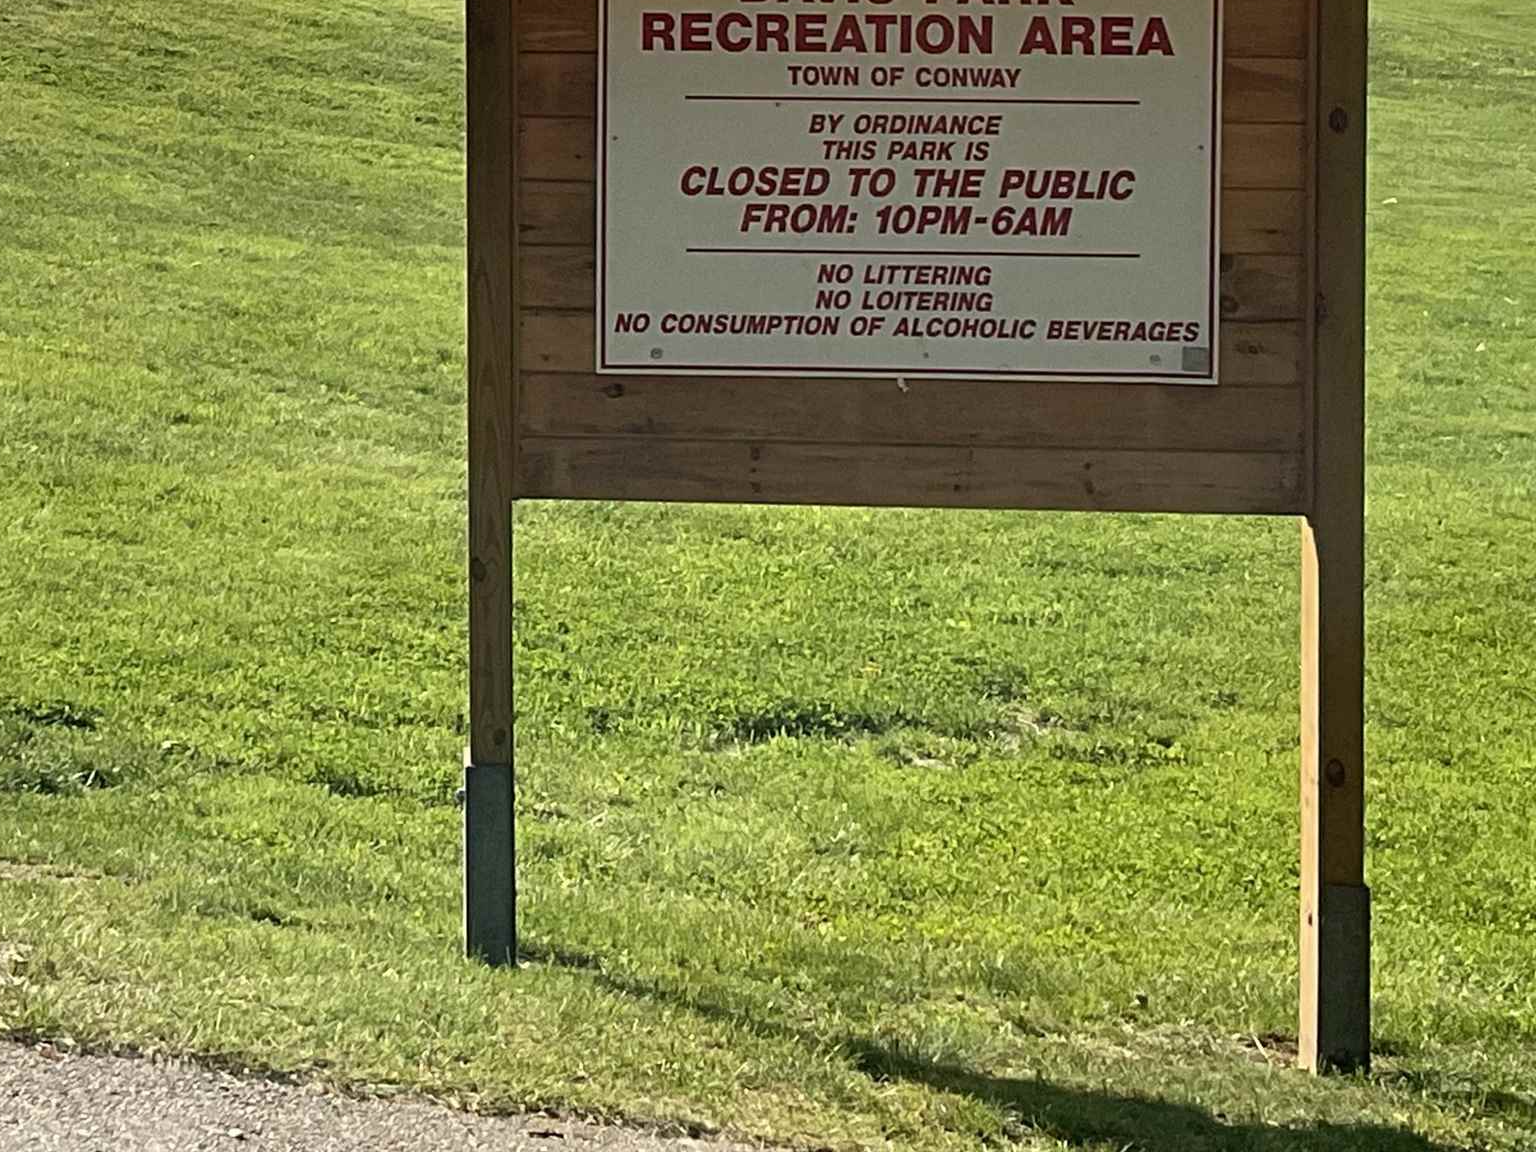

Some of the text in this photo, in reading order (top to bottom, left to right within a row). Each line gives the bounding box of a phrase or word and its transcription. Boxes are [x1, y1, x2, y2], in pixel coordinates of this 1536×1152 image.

[641, 11, 1176, 57] RECREATION AREA
[786, 65, 1022, 89] TOWN OF CONWAY
[808, 113, 1003, 136] BY ORDINANCE
[822, 139, 990, 162] THIS PARK IS
[680, 165, 1136, 201] CLOSED TO THE PUBLIC
[740, 203, 1074, 237] FROM: 10PM-6AM
[816, 263, 992, 287] NO LITTERING
[815, 289, 994, 313] NO LOITERING
[613, 312, 1201, 343] NO CONSUMPTION OF ALCOHOLIC BEVERAGES
